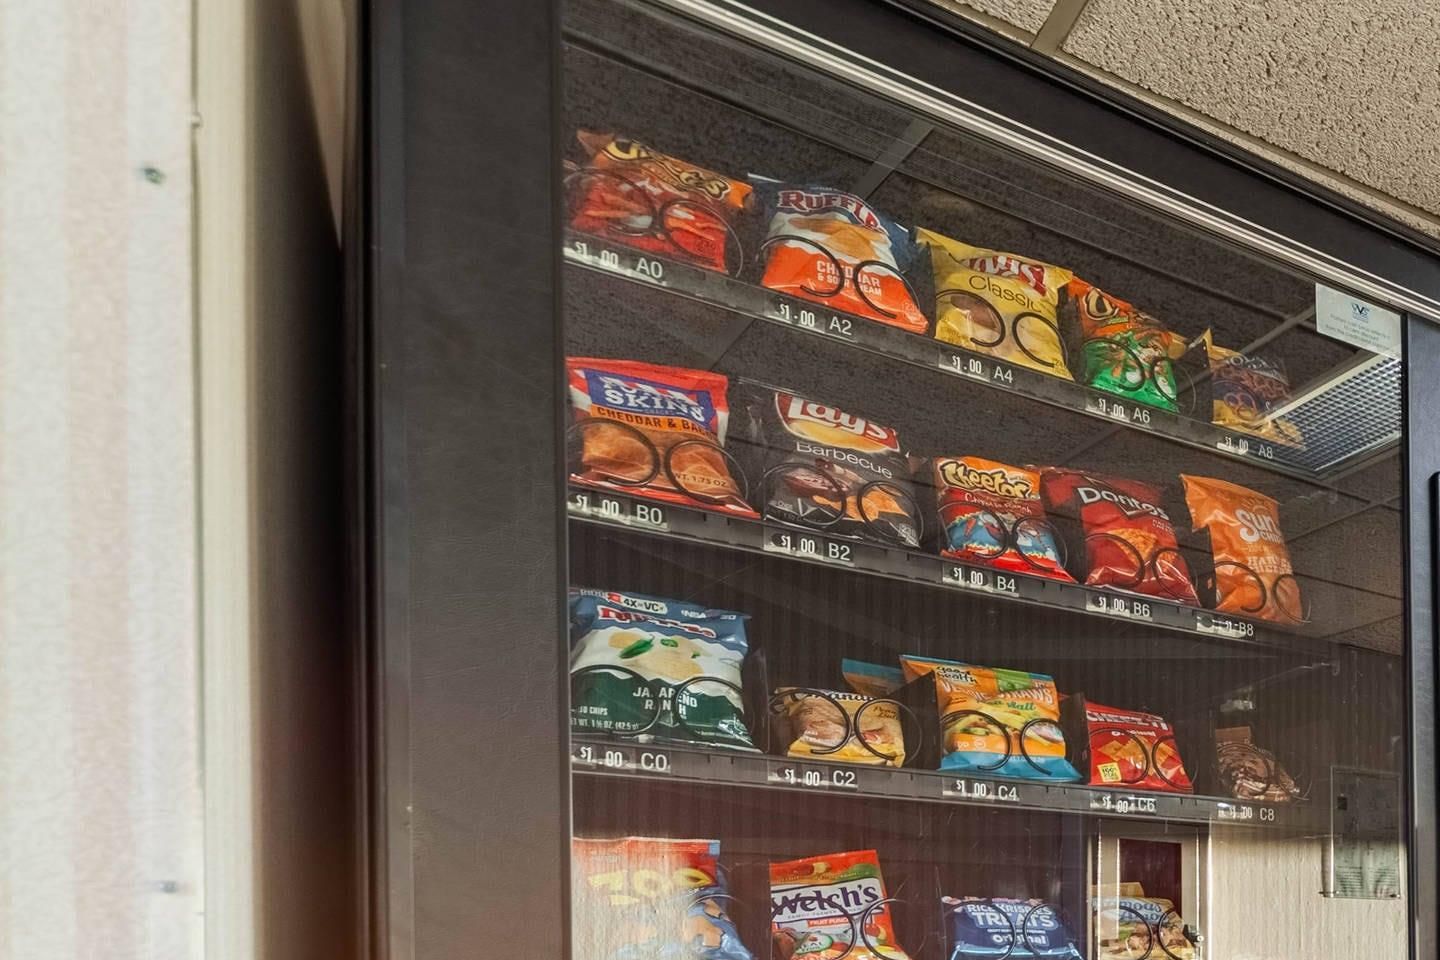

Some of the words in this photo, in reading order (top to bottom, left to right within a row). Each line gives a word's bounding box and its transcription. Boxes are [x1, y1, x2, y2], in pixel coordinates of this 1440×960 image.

[636, 257, 663, 279] A0
[829, 316, 852, 336] A2
[993, 365, 1014, 384] A4
[603, 389, 706, 423] SKINS
[597, 406, 663, 428] CHEDDAR
[667, 418, 677, 429] &
[1132, 407, 1151, 425] A6
[795, 441, 893, 480] Barbecue
[1258, 443, 1273, 460] A8
[1077, 487, 1170, 523] Doritos
[636, 504, 663, 526] B0
[828, 541, 851, 563] B2
[996, 575, 1017, 594] B4
[1133, 603, 1151, 618] B6
[1237, 622, 1255, 637] B8
[640, 752, 668, 772] C0
[832, 770, 856, 787] C2
[998, 785, 1018, 801] C4
[1137, 798, 1156, 813] C6
[1259, 807, 1275, 822] C8
[771, 884, 880, 917] Welch's
